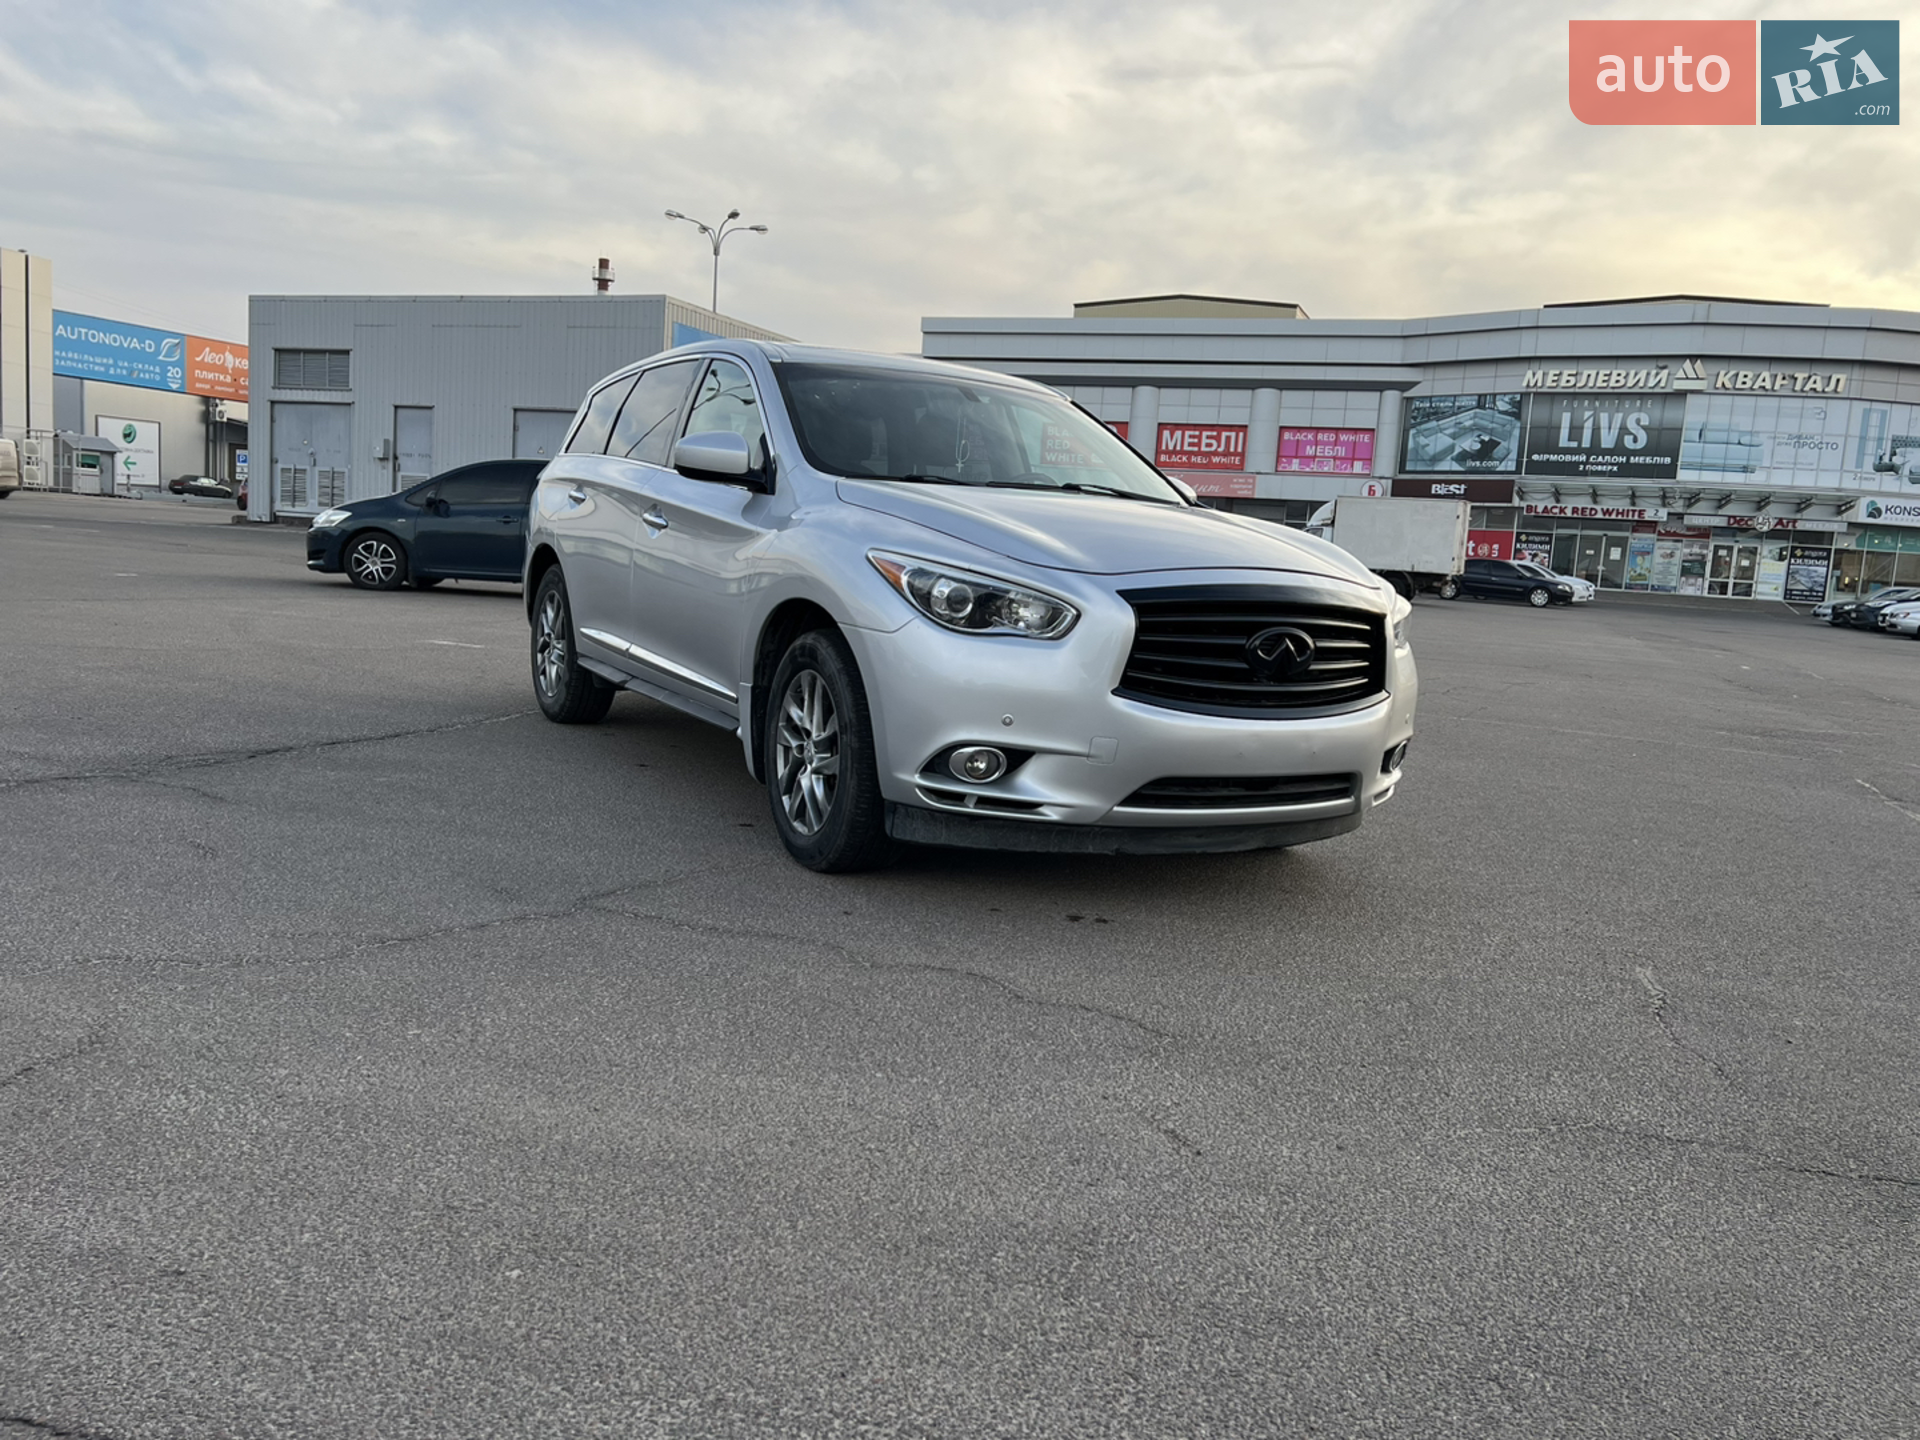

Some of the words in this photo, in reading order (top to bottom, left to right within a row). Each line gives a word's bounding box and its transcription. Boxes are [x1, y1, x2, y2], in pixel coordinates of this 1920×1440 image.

[55, 324, 155, 353] AUTONOVA-D
[195, 346, 224, 366] Лео
[167, 366, 181, 378] 20
[195, 369, 232, 383] плитка
[1522, 364, 1669, 389] МЕБЛЕВИЙ
[1715, 369, 1847, 393] КВАРТАЛ
[1562, 399, 1652, 408] FURNITURE
[1161, 429, 1244, 453] МЕБЛІ
[1283, 431, 1314, 440] BLACK
[1317, 433, 1336, 441] RED
[1340, 434, 1370, 443] WHITE
[1305, 445, 1346, 457] МЕБЛІ
[1793, 441, 1839, 451] ПРОСТО
[1160, 453, 1188, 463] BLACK
[1191, 455, 1209, 464] RED
[1211, 455, 1241, 465] WHITE
[1466, 459, 1500, 467] livs.com
[1531, 453, 1586, 463] ФІРМОВИЙ
[1589, 454, 1627, 464] САЛОН
[1629, 455, 1672, 465] МЕБЛІВ
[1585, 464, 1619, 472] ПОВЕРХ
[1525, 504, 1568, 516] BLACK
[1571, 506, 1598, 517] RED
[1601, 507, 1647, 519] WHITE
[1774, 517, 1798, 529] Art
